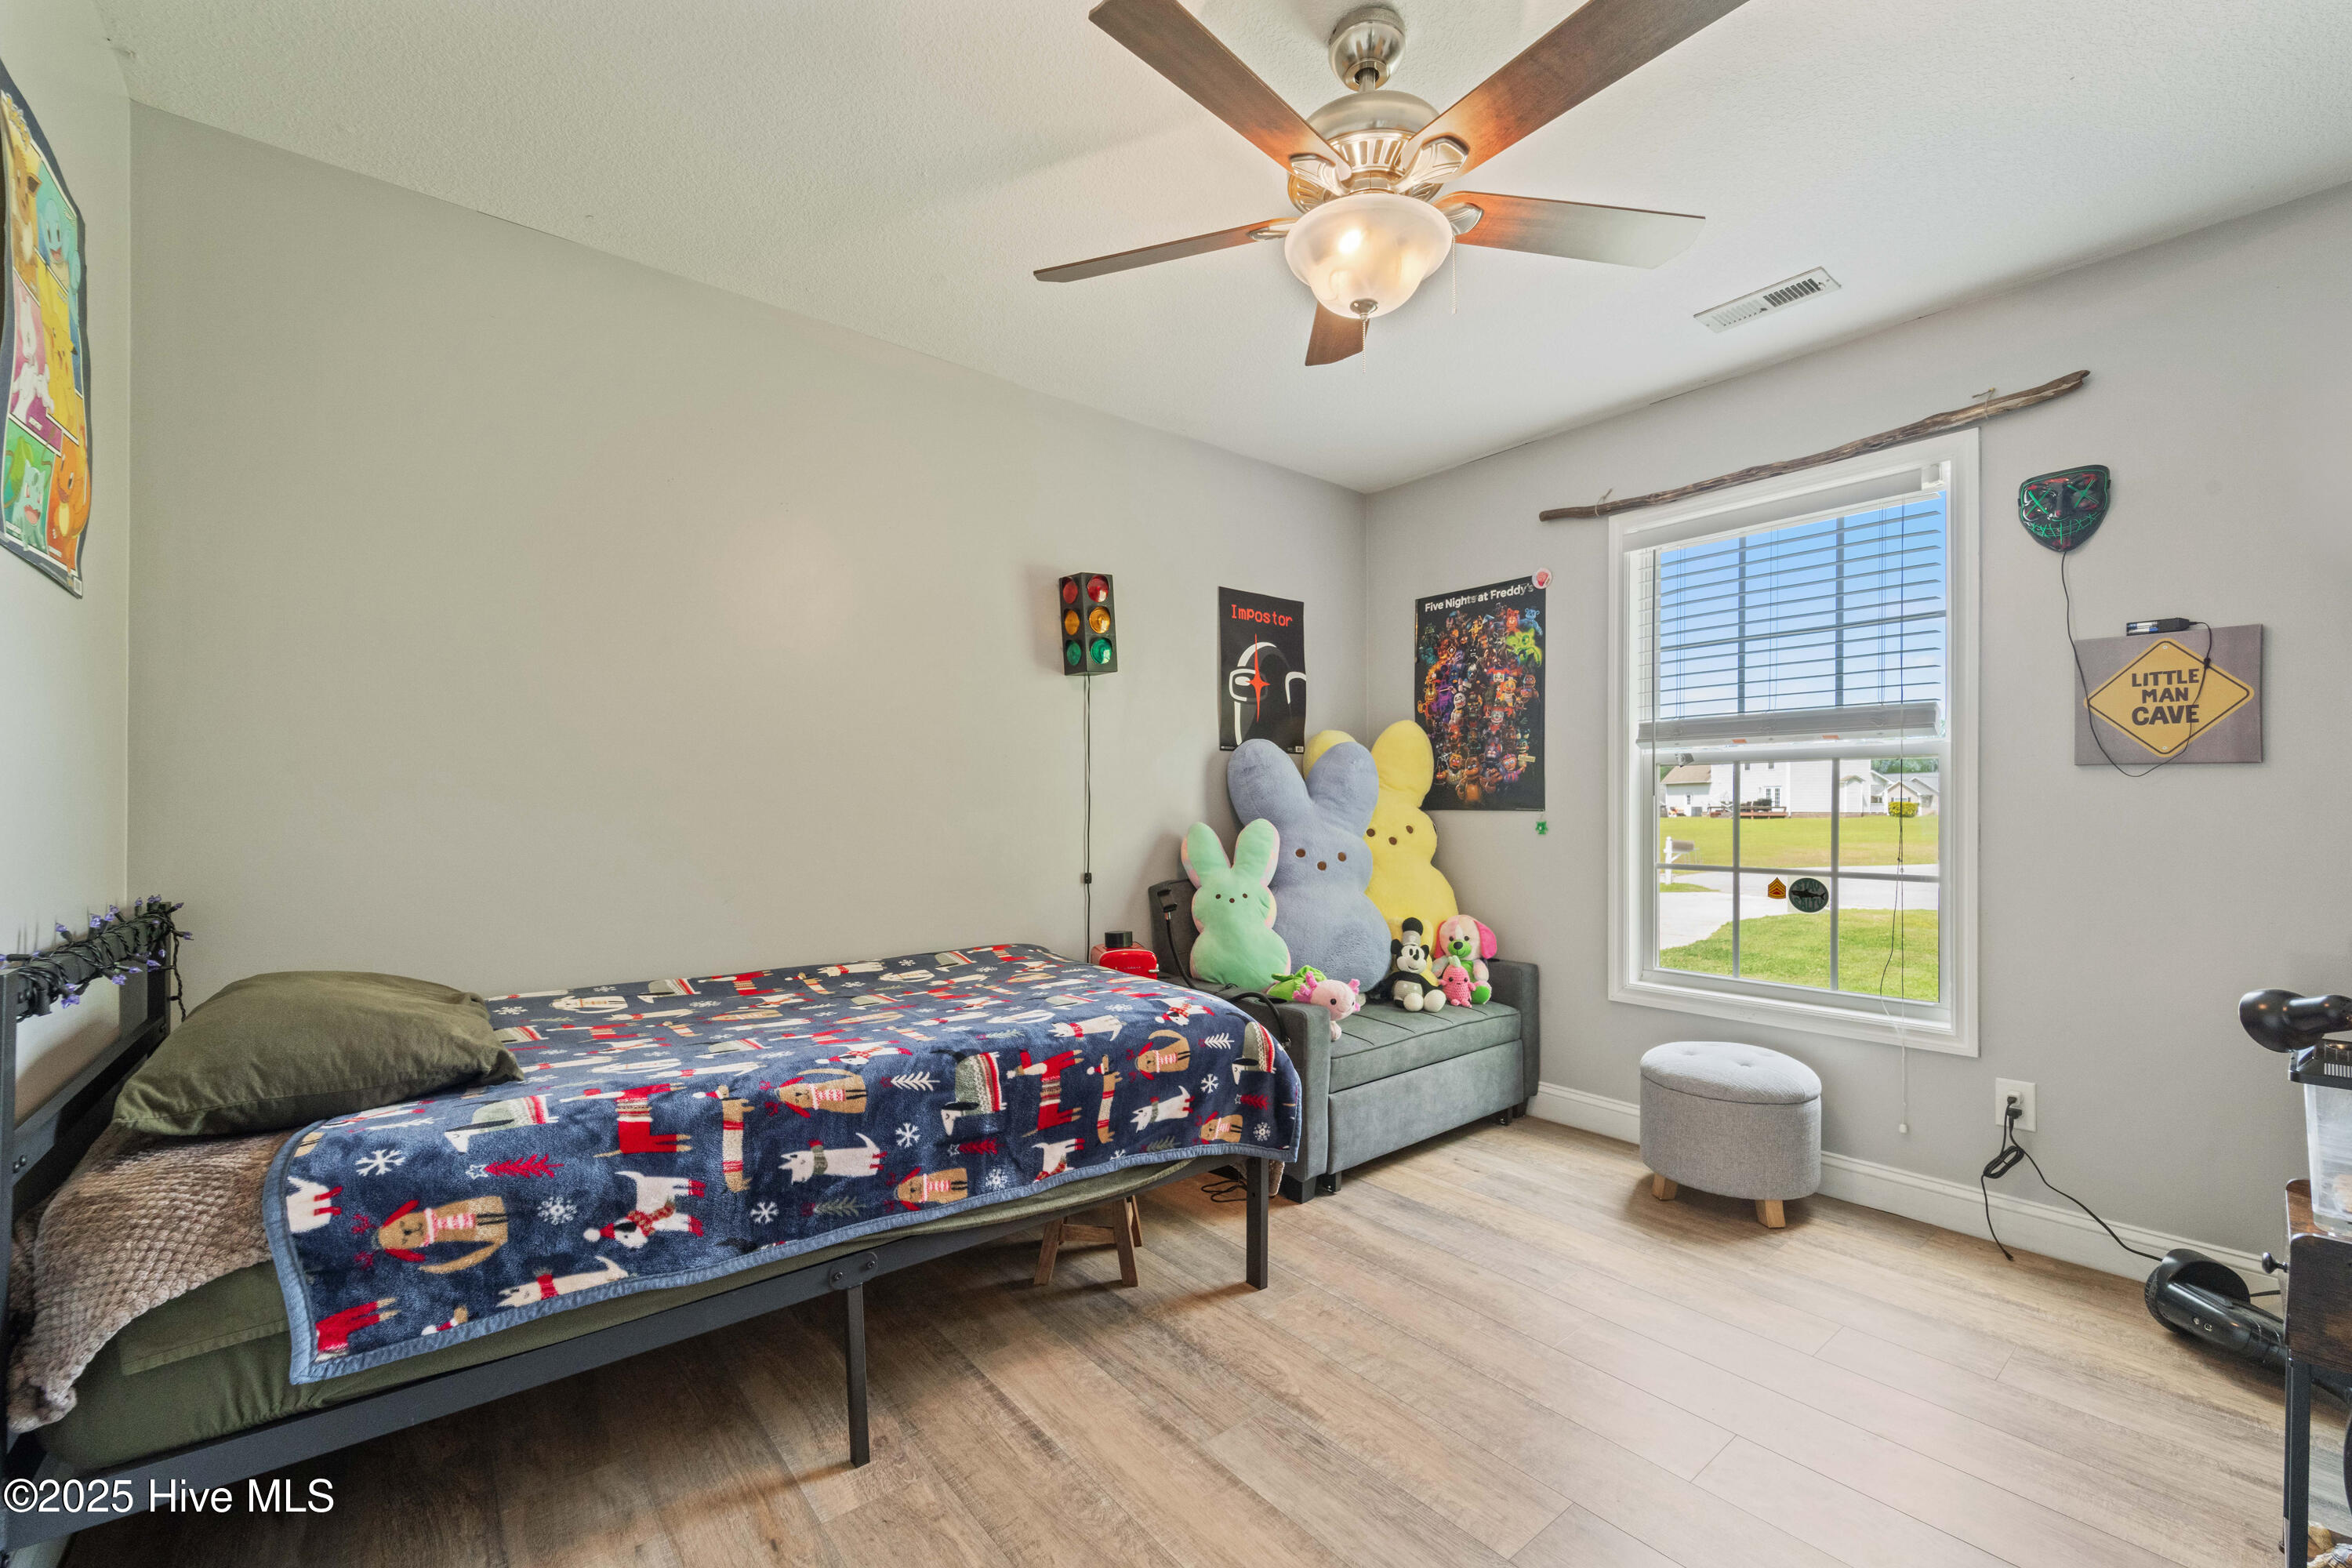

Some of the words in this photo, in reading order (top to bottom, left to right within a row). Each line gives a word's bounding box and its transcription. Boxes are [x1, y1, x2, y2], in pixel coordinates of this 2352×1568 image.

[1425, 601, 1444, 612] Five
[1445, 595, 1477, 609] Nights
[1478, 593, 1488, 603] at
[1490, 583, 1534, 600] Freddy's
[1231, 604, 1293, 627] Impostor
[2132, 668, 2199, 687] LITTLE
[2142, 687, 2189, 704] MAN
[2132, 704, 2199, 726] CAVE
